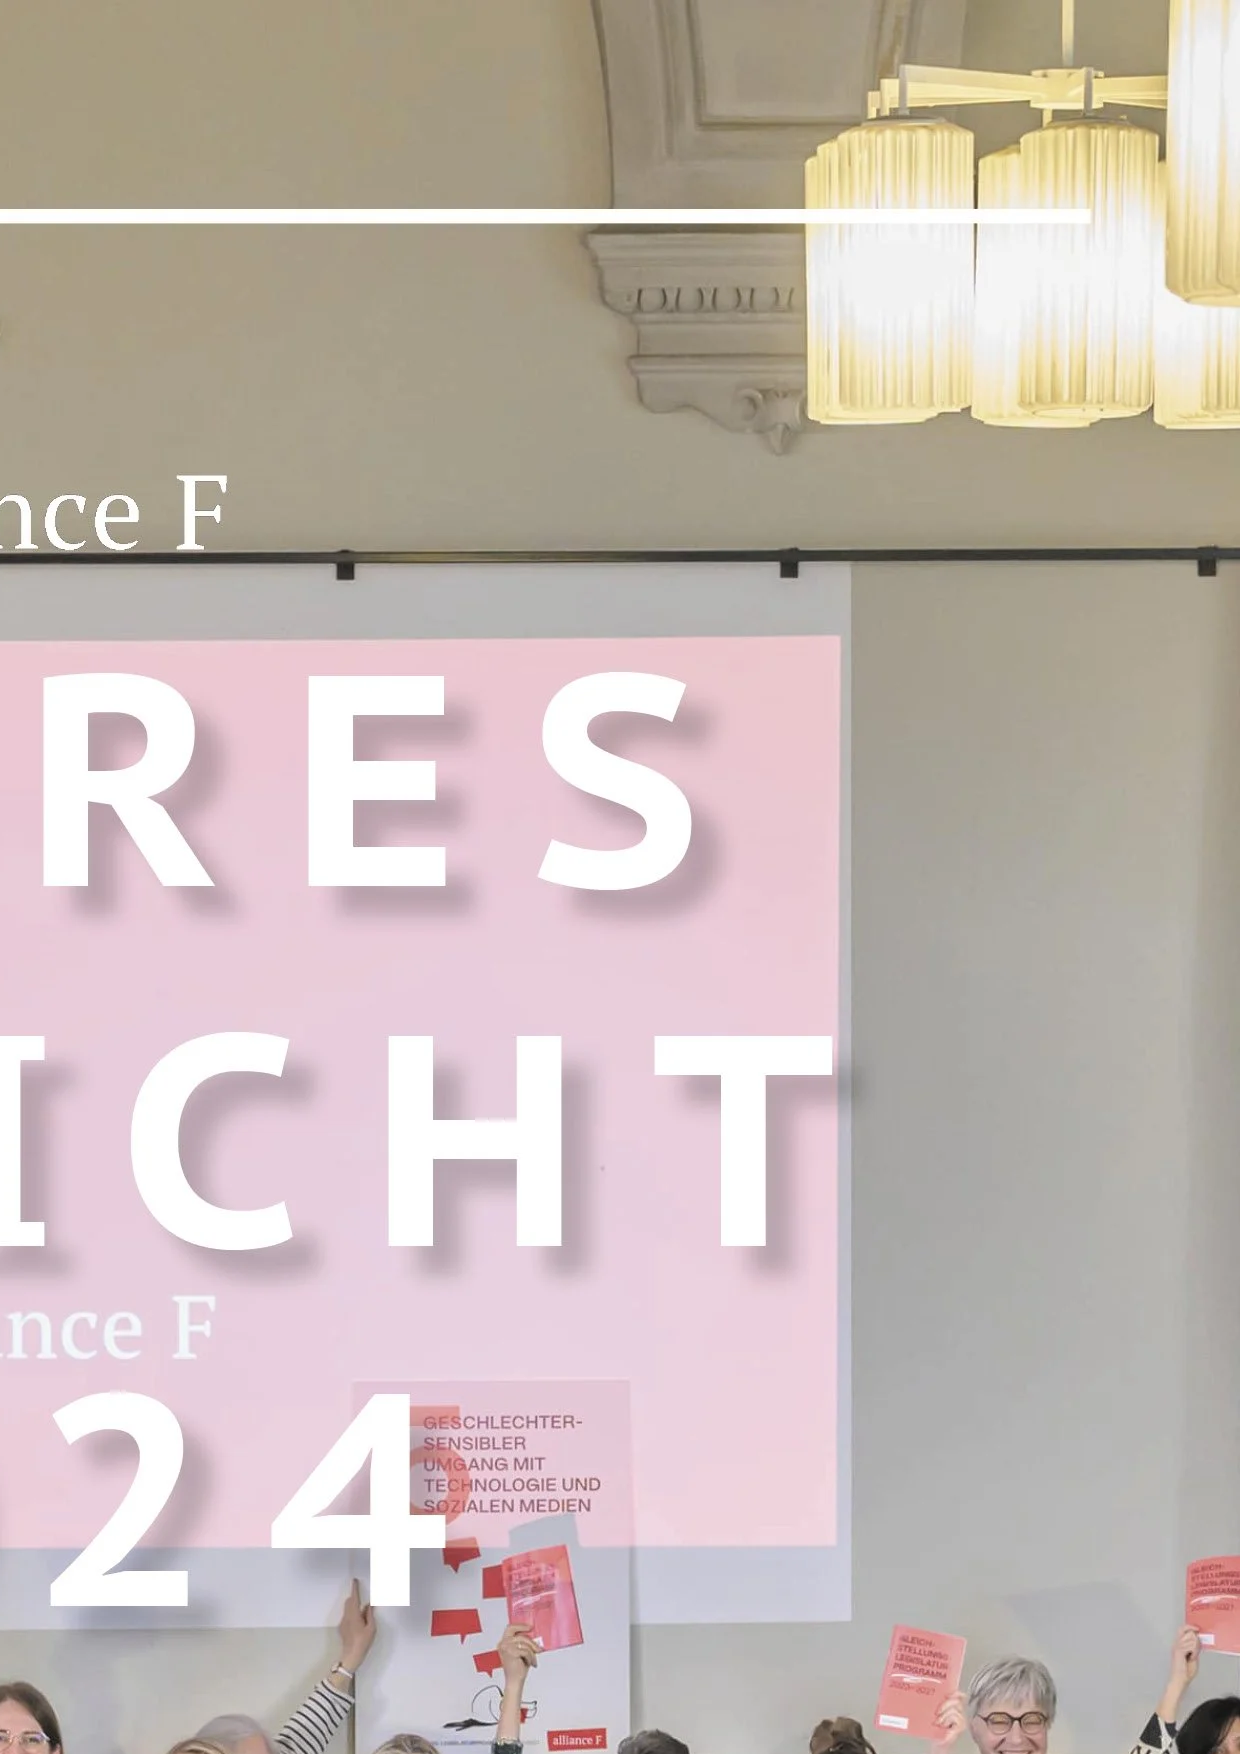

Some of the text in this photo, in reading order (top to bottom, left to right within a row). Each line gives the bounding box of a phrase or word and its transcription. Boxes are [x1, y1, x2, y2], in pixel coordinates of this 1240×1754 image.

[172, 1296, 216, 1359] F
[423, 1415, 583, 1430] GESCHLECHTER-
[423, 1436, 526, 1451] SENSIBLER
[423, 1457, 546, 1472] UMGANG MIT
[424, 1477, 601, 1493] TECHNOLOGIE UND
[424, 1498, 591, 1513] SOZIALEN MEDIEN
[553, 1734, 593, 1746] alliance
[595, 1735, 602, 1745] F
